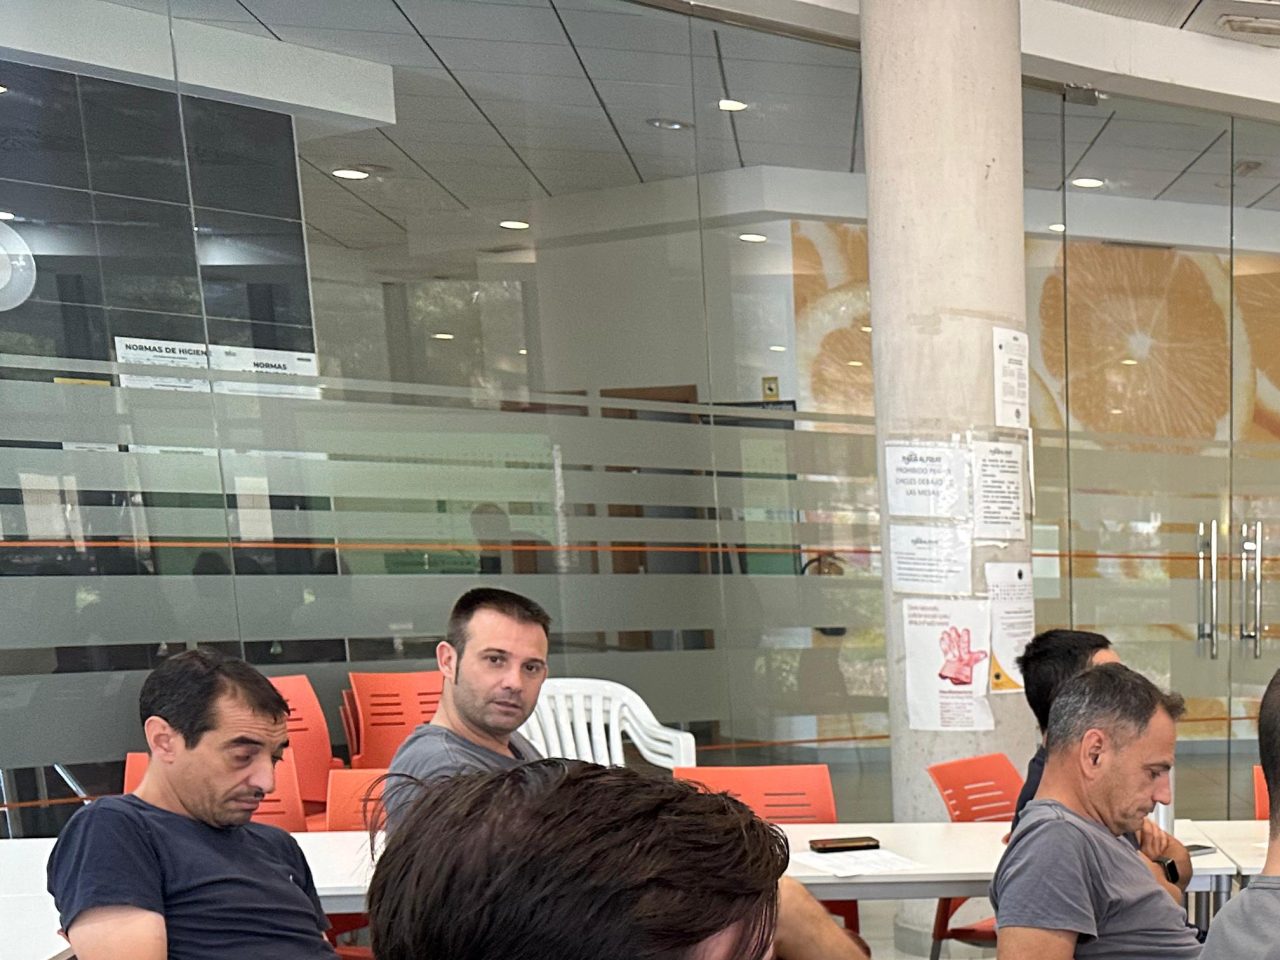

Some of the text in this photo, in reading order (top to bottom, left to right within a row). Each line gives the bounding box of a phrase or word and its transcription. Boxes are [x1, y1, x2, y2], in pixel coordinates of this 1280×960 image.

[125, 343, 163, 354] NORMAS
[165, 346, 177, 355] DE
[253, 361, 288, 371] NORMAS
